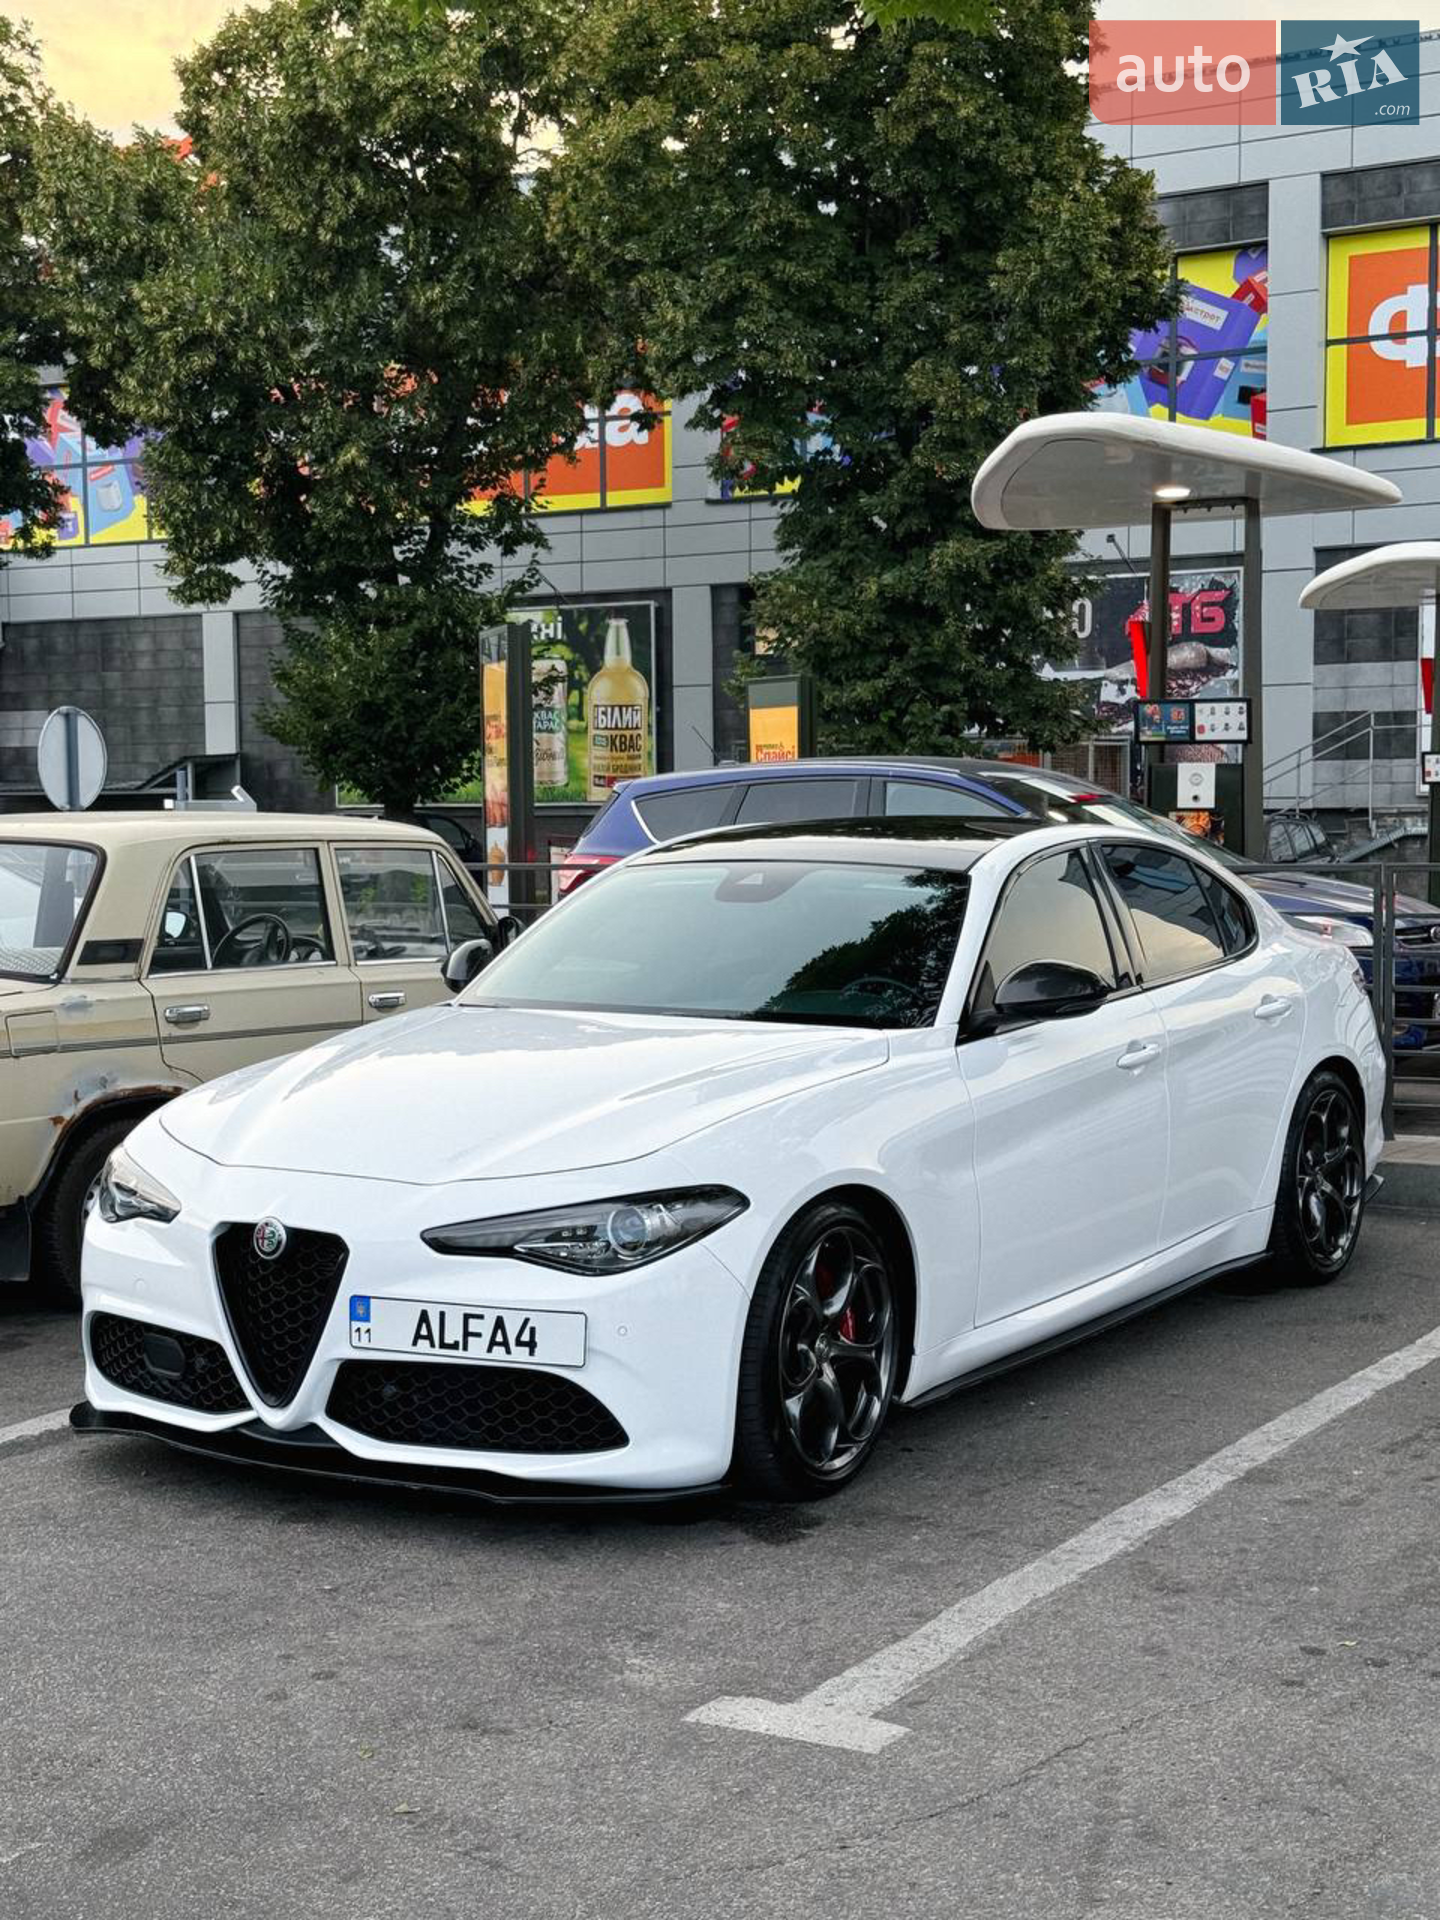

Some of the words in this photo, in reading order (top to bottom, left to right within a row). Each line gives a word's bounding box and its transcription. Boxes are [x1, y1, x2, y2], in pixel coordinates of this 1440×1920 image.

[597, 706, 642, 729] БІЛИЙ
[610, 734, 642, 753] КВАС
[354, 1327, 372, 1343] 11
[412, 1309, 538, 1356] ALFA4
